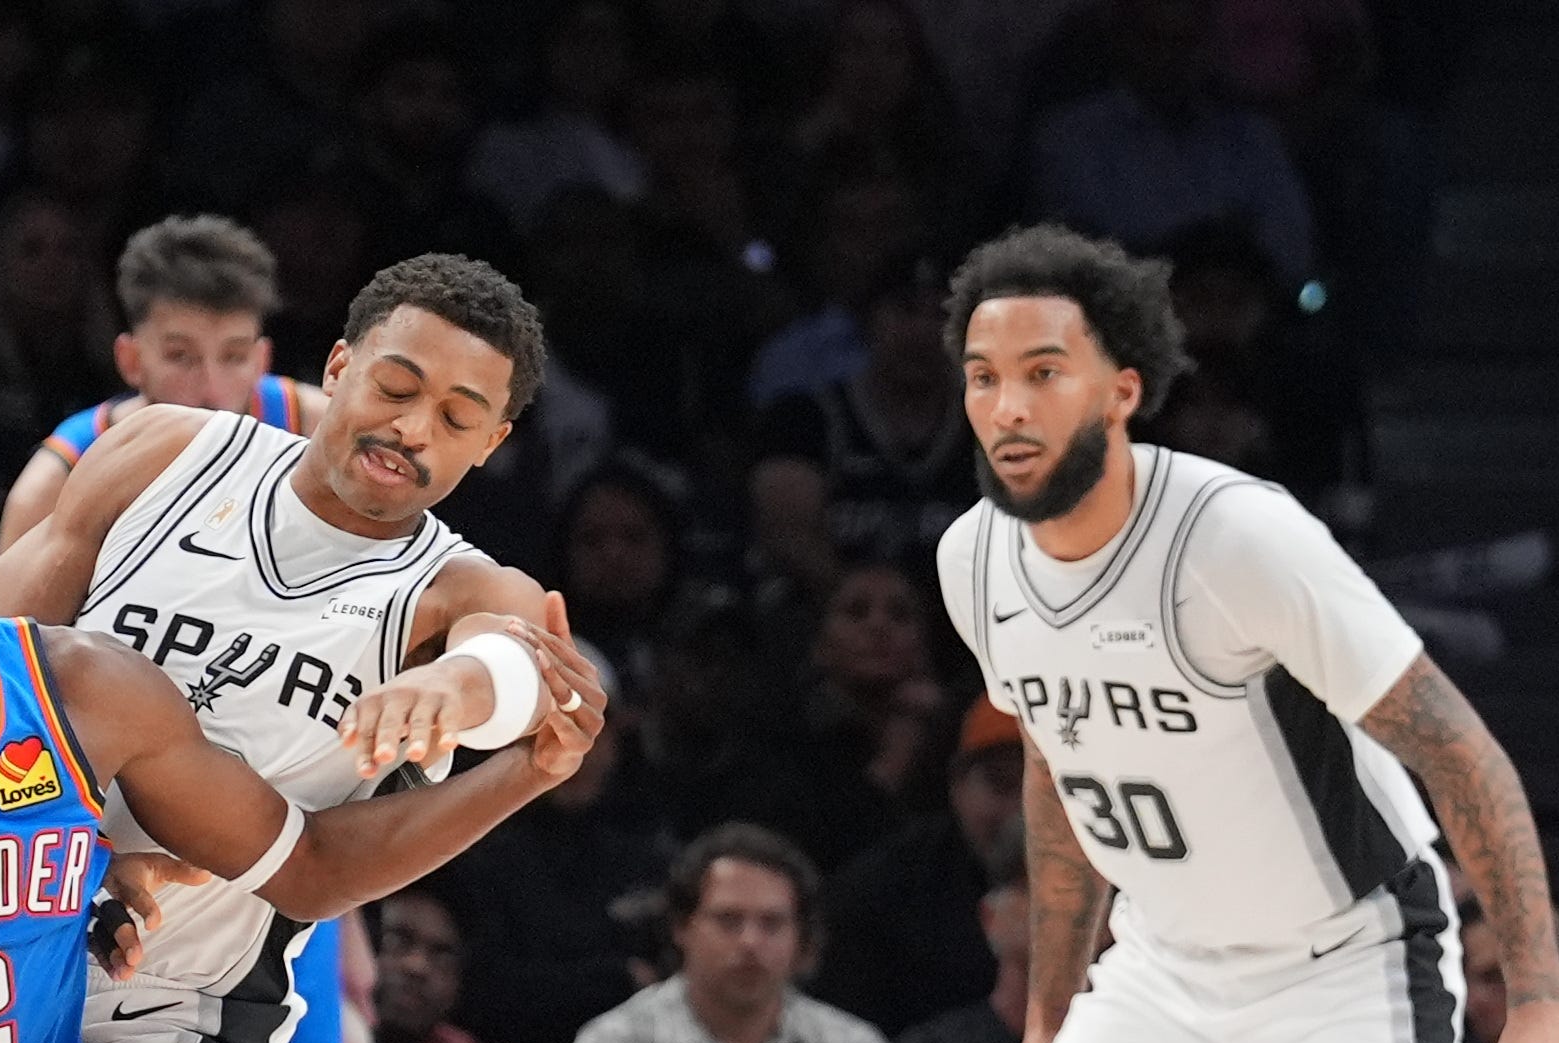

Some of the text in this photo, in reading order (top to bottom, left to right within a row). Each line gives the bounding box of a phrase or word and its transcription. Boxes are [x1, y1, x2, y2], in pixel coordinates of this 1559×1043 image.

[331, 603, 384, 620] LEDGER
[1002, 675, 1198, 751] PURS
[1059, 774, 1189, 861] 30
